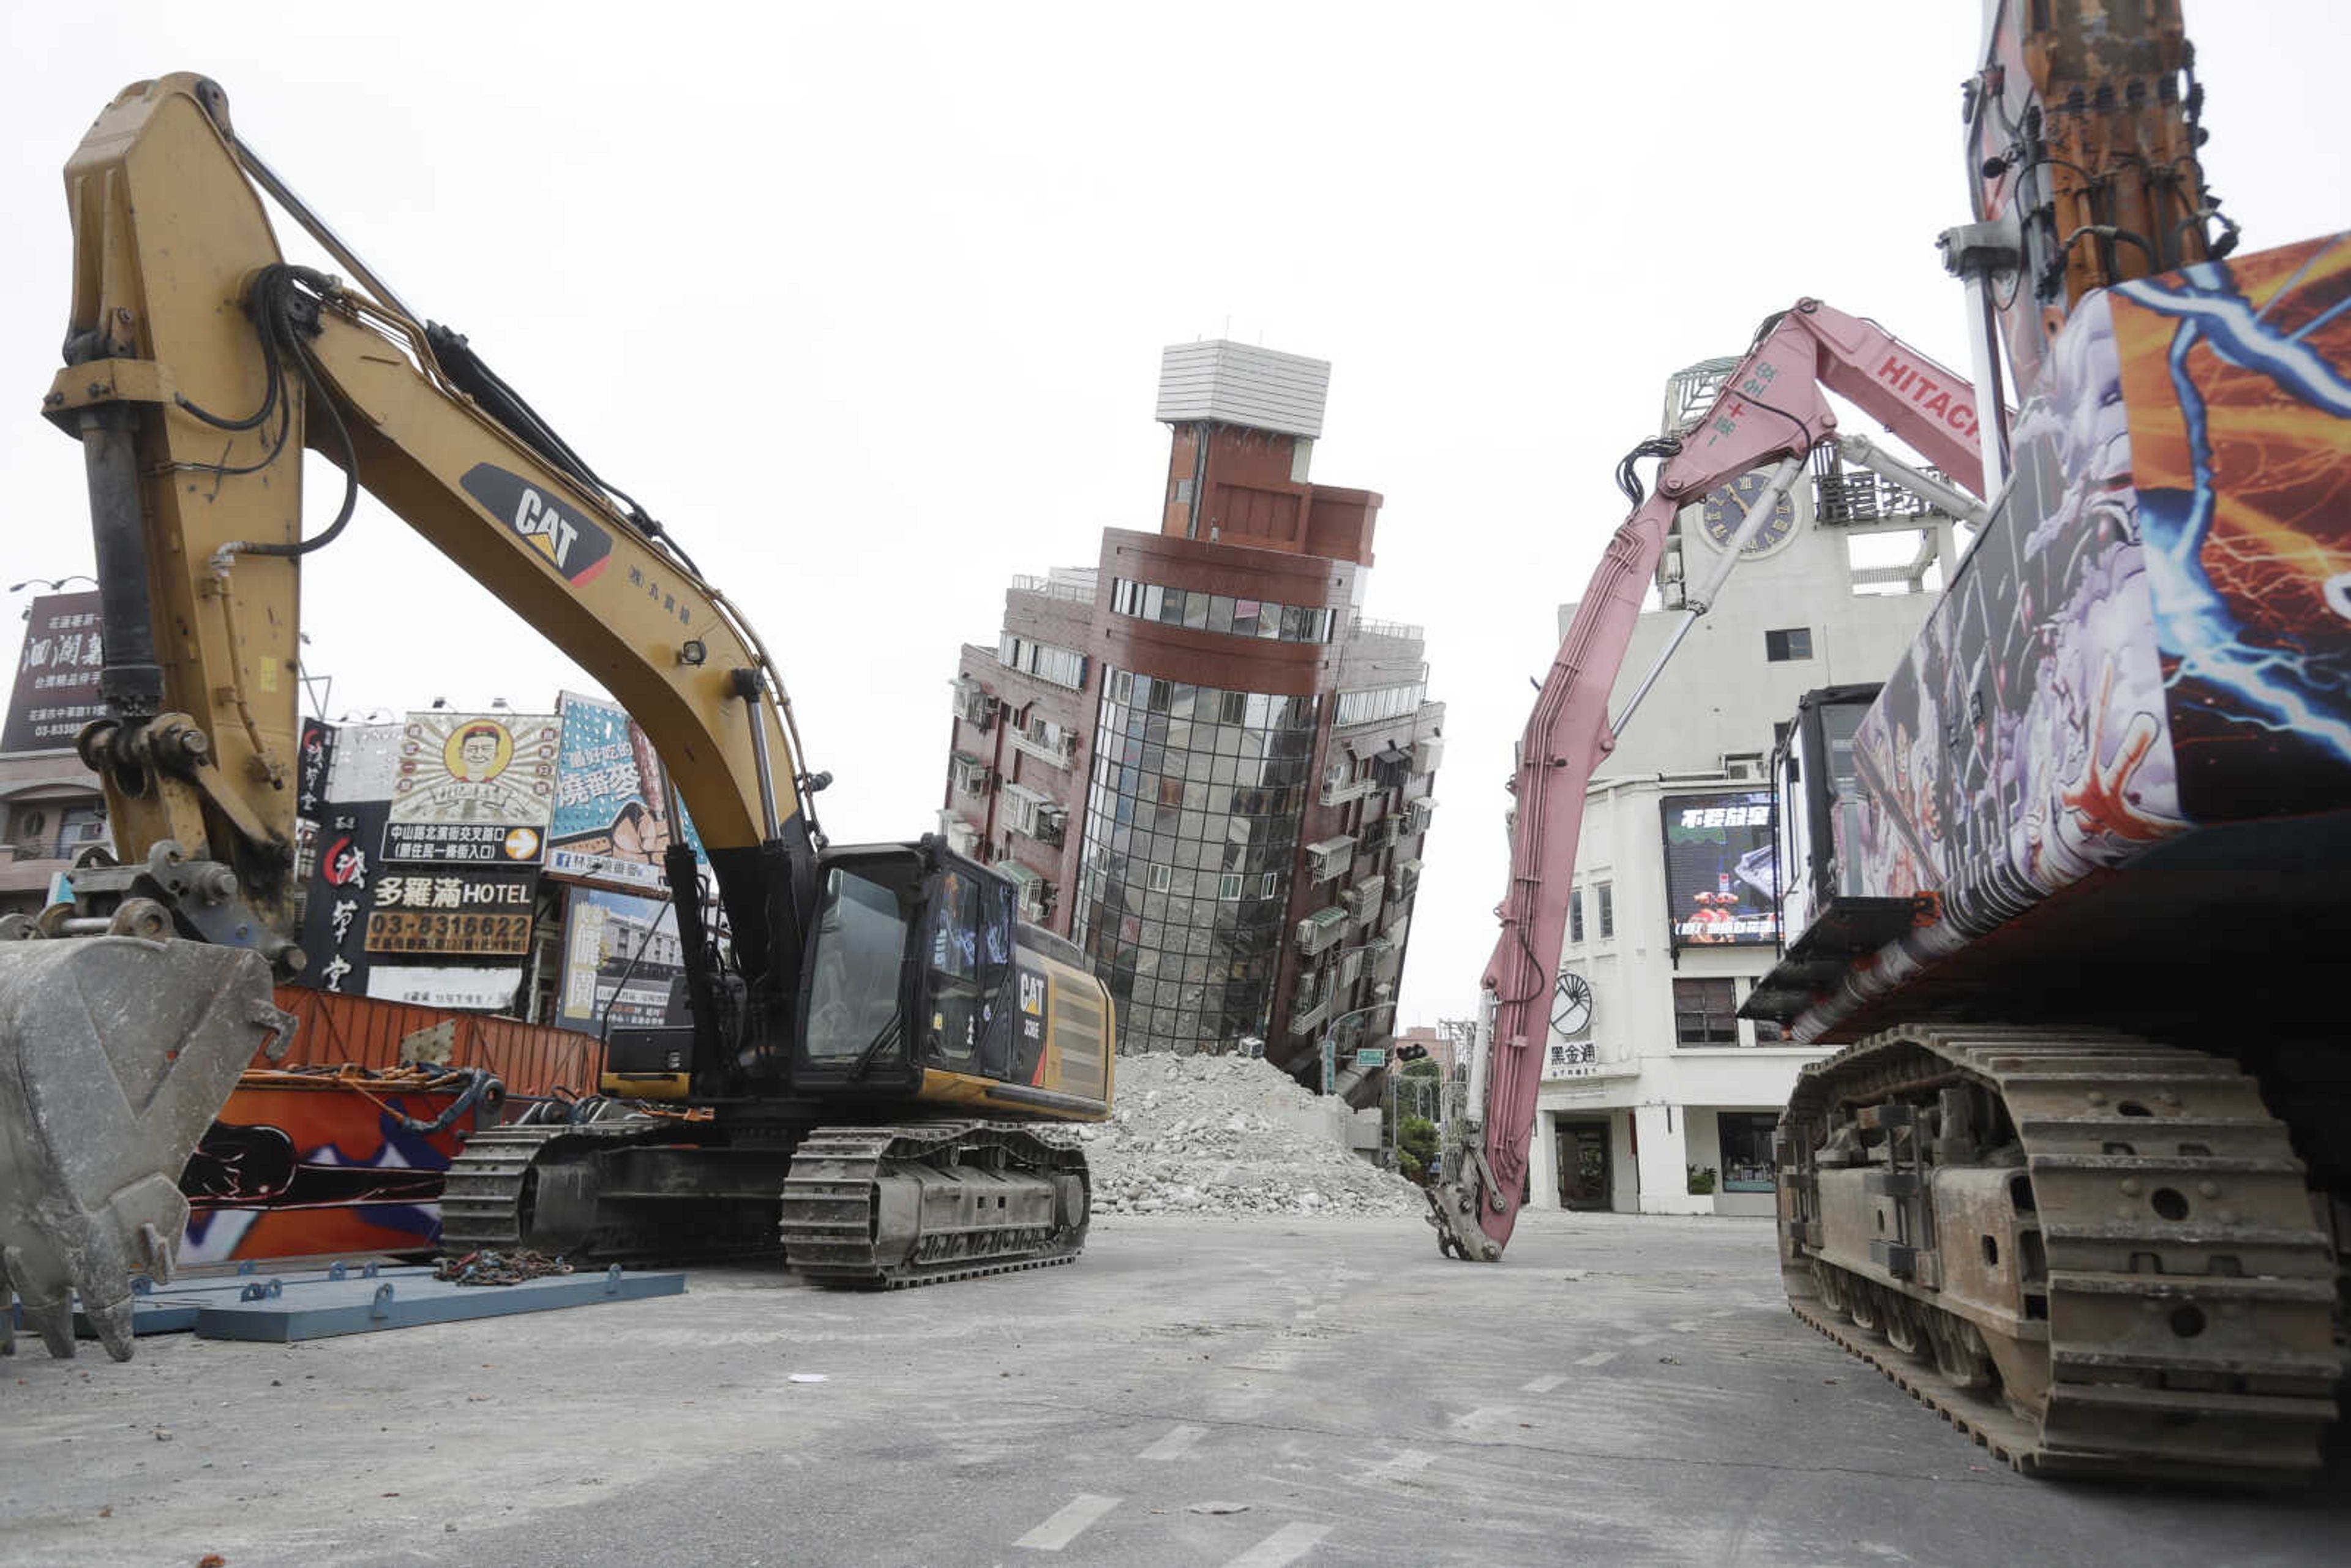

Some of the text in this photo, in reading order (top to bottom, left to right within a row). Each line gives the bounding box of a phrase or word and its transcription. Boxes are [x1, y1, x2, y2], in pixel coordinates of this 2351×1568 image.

[516, 488, 579, 568] CAT
[375, 877, 531, 907] 多羅滿 HOTEL
[1021, 973, 1044, 1016] CAT
